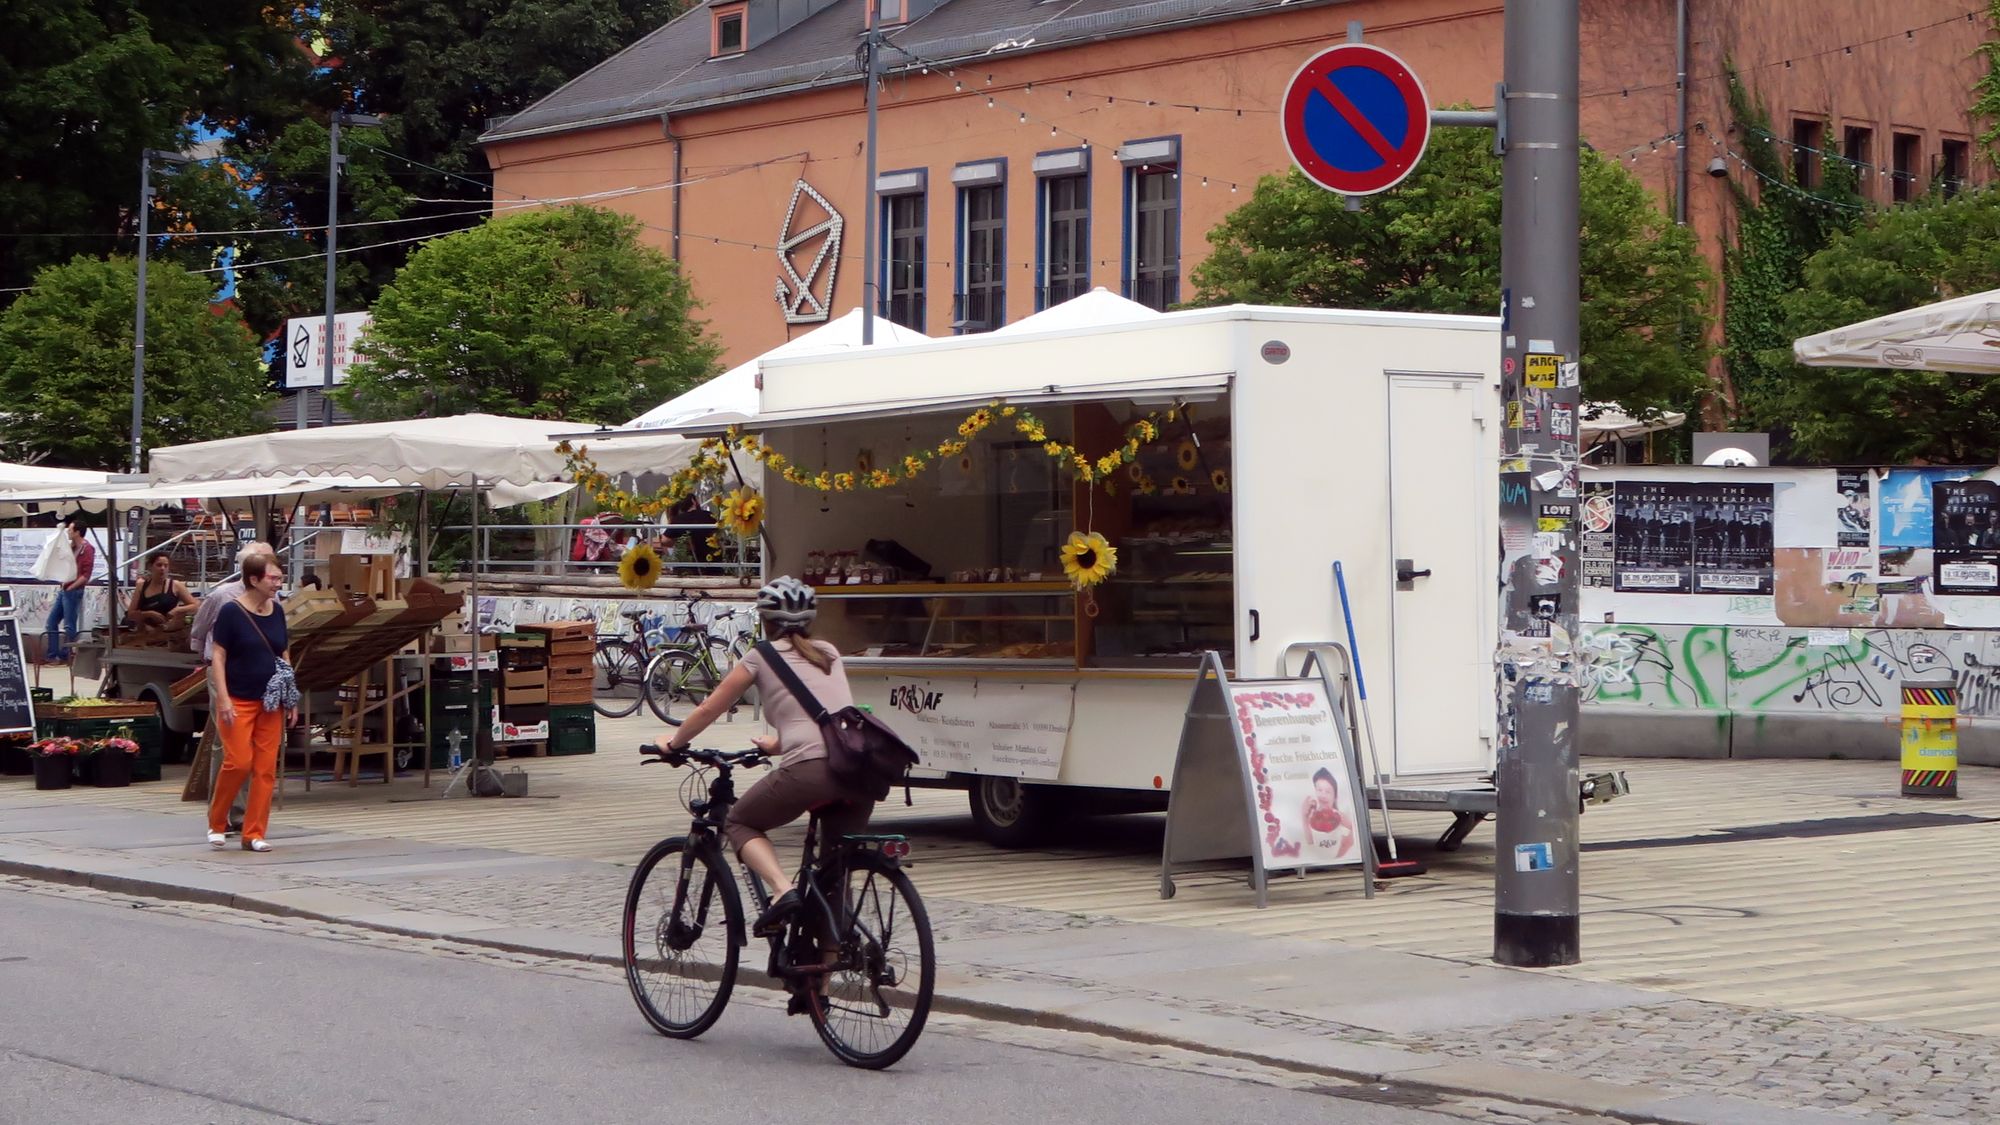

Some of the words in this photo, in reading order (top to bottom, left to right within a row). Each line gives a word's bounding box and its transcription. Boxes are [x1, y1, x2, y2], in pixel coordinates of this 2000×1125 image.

[1642, 486, 1667, 494] THE
[1722, 487, 1746, 495] THE
[1945, 488, 1966, 496] THE
[1617, 494, 1691, 503] PINEAPPLE
[1697, 495, 1771, 503] PINEAPPLE
[1947, 494, 1990, 505] HIRSCH
[1543, 505, 1572, 515] LOVE
[1635, 503, 1673, 511] THIEF
[1714, 504, 1753, 512] THIEF
[1945, 505, 1988, 514] EFFEKT
[1254, 711, 1327, 727] Beerenhunger?
